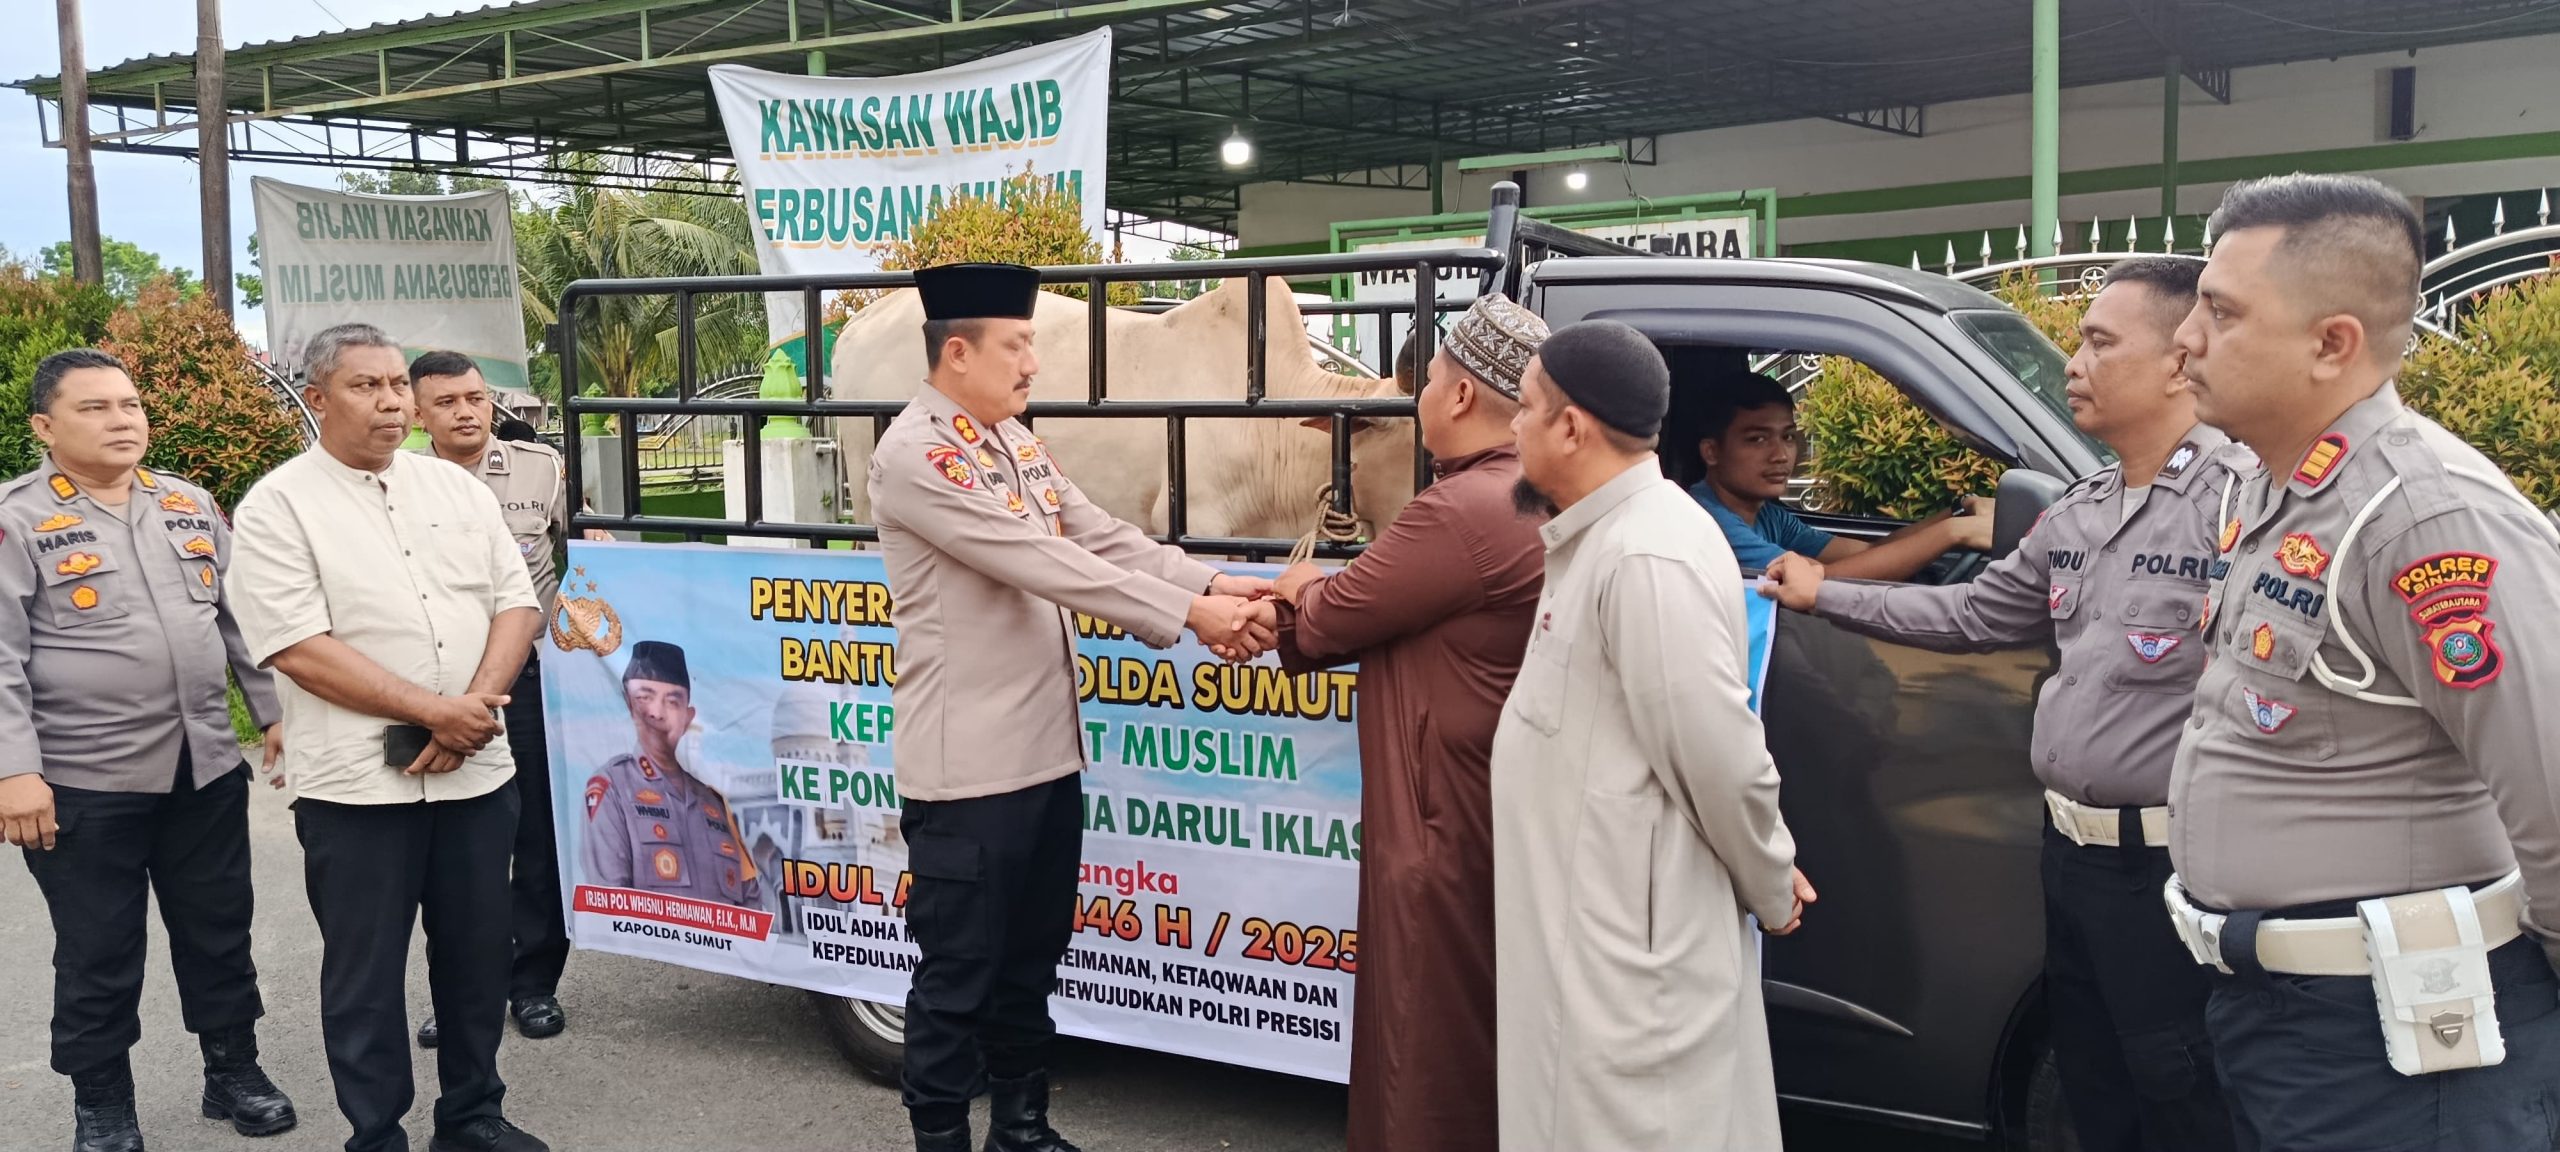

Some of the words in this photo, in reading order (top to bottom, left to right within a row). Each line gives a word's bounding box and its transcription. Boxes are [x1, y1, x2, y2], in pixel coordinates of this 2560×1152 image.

[757, 94, 936, 155] KAWASAN
[943, 79, 1063, 147] WAJIB
[37, 530, 97, 552] HARIS
[165, 518, 211, 532] POLRI
[2131, 553, 2209, 580] POLRI
[2398, 557, 2489, 591] POLRES
[2413, 572, 2479, 593] BINJAI
[751, 577, 895, 627] PENYER
[2252, 571, 2325, 618] POLRI
[1193, 662, 1358, 722] SUMUT
[1122, 724, 1297, 780] MUSLIM
[781, 764, 821, 801] KE
[829, 769, 906, 809] PON
[1126, 797, 1251, 849] DARUL
[585, 890, 608, 907] IRJEN
[610, 892, 629, 911] POL
[630, 895, 664, 916] WHISNU
[666, 900, 715, 928] HERMAWAN,
[782, 859, 883, 906] IDUL
[1155, 904, 1191, 949] H
[1242, 918, 1358, 974] 2025
[612, 921, 680, 941] KAPOLDA
[685, 932, 732, 951] SUMUT
[807, 912, 846, 934] IDUL
[851, 918, 899, 942] ADHA
[1061, 948, 1157, 984] EIMANAN,
[1162, 961, 1287, 998] KETAQWAAN
[1293, 981, 1338, 1008] DAN
[812, 941, 918, 972] KEPEDULIAN
[1189, 999, 1250, 1028] POLRI
[1256, 1010, 1340, 1042] PRESISI
